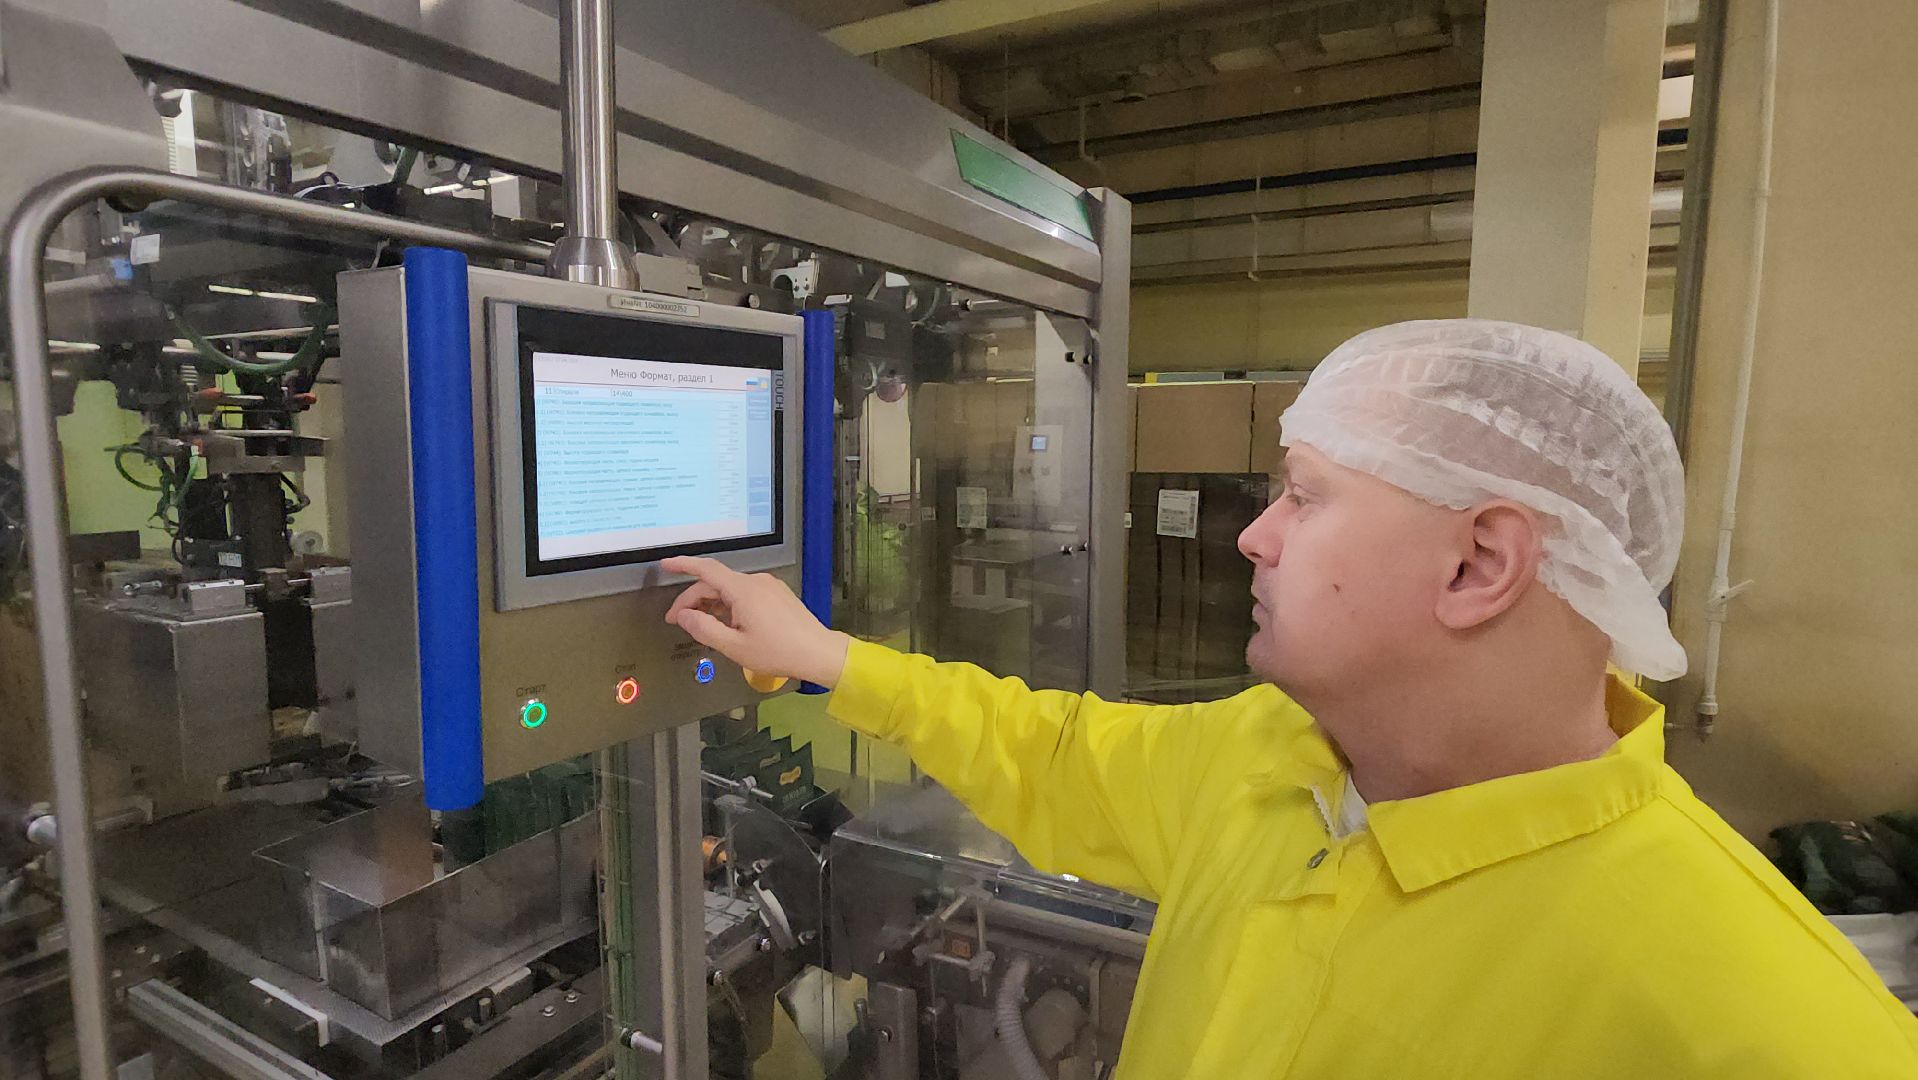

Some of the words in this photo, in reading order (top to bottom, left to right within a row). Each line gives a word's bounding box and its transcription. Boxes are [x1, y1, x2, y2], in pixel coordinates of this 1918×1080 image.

[611, 368, 637, 379] Меню
[640, 371, 676, 382] Формат,
[678, 374, 706, 383] раздел
[774, 370, 785, 410] TOUCH
[516, 684, 546, 697] Старт
